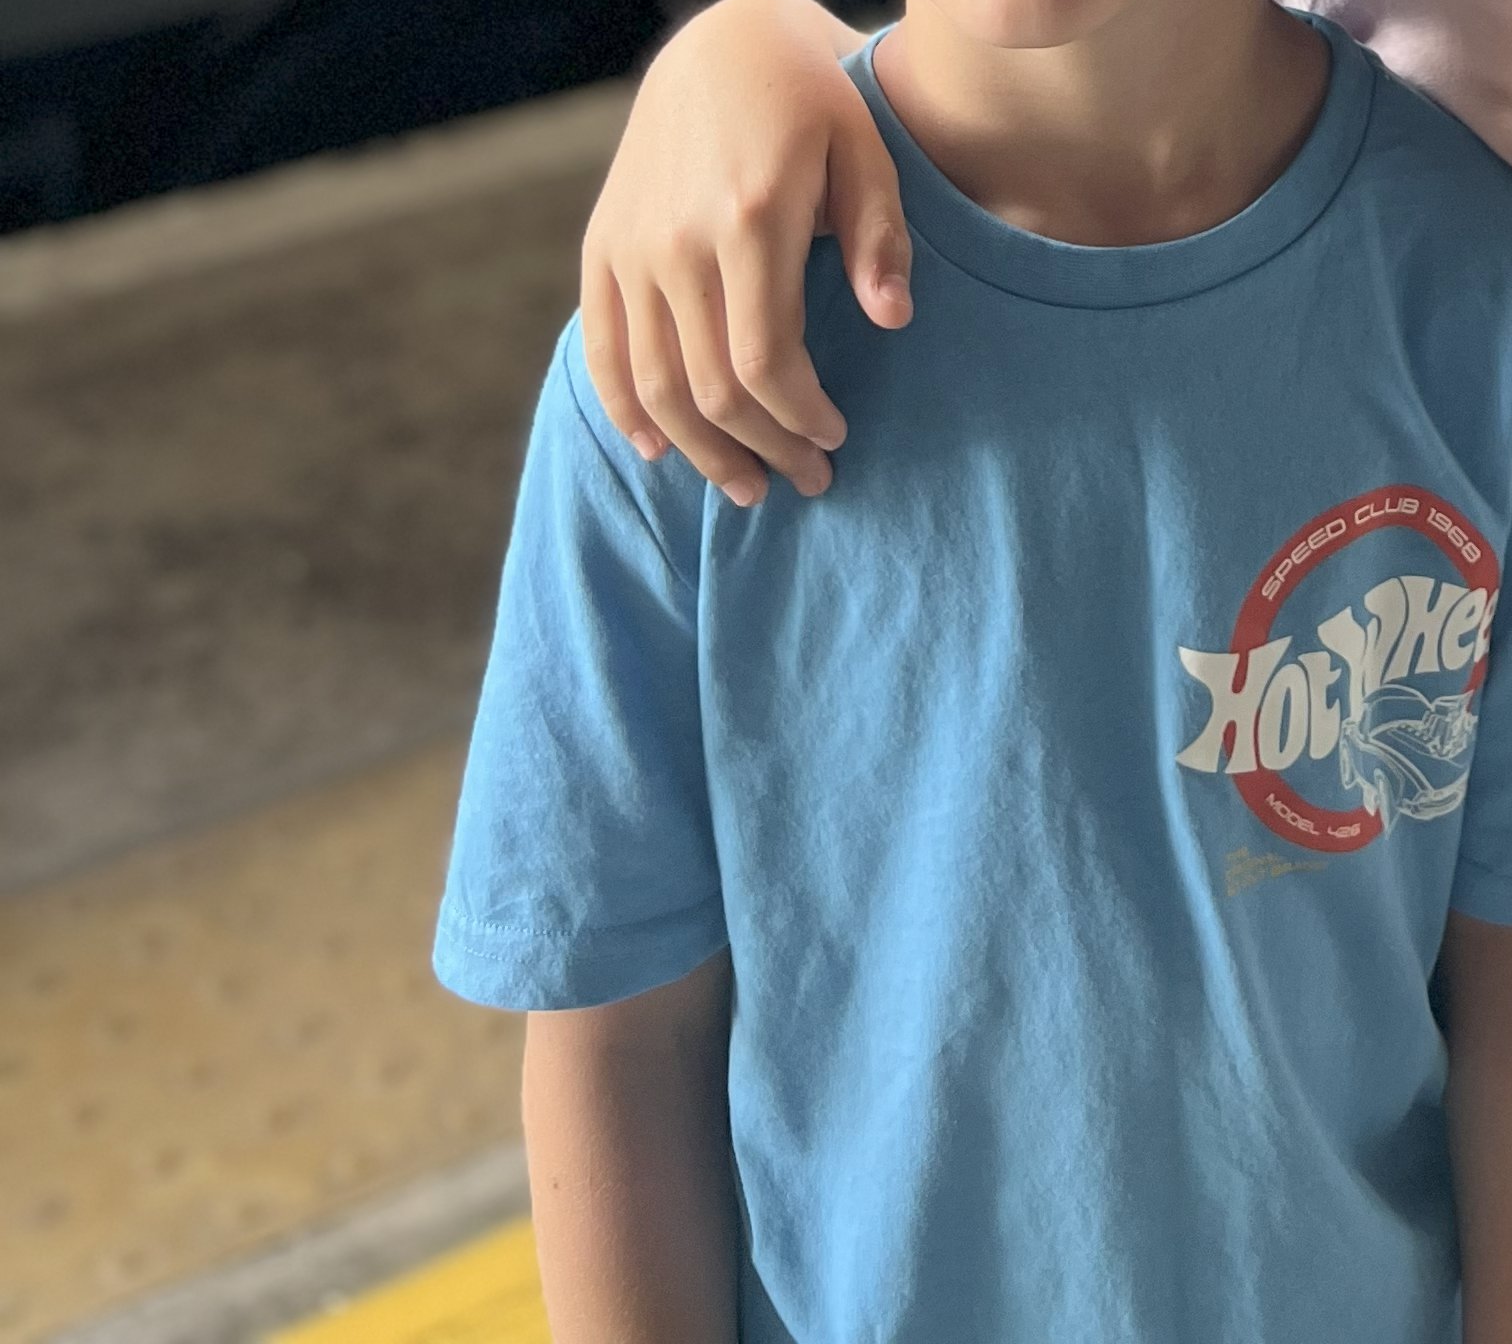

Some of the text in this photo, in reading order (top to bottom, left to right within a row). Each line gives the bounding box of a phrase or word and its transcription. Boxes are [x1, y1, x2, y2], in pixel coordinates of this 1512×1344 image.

[1261, 497, 1482, 600] SPEED CLUB 1968
[1265, 793, 1320, 836] MODEL
